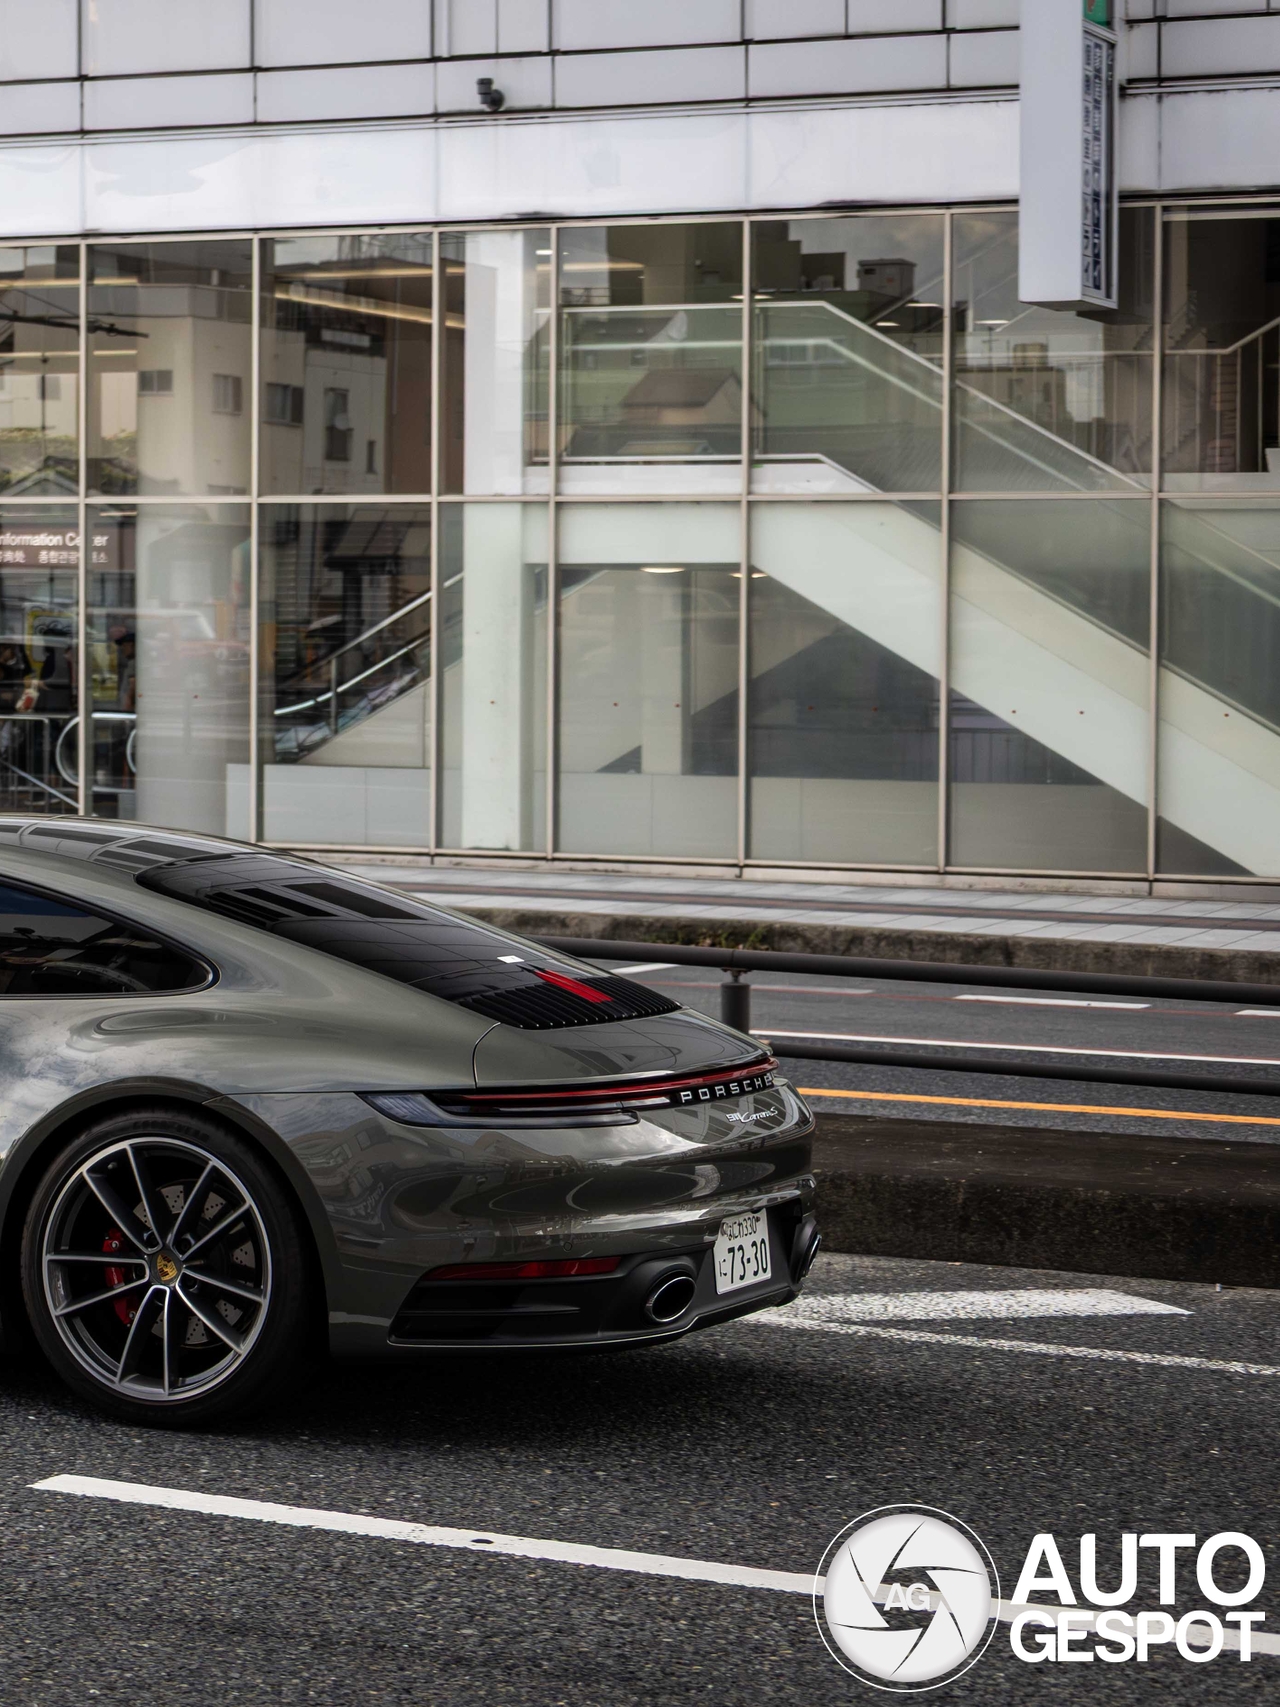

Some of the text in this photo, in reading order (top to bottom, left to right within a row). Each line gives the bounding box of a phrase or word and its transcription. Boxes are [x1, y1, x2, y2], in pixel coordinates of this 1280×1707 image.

[65, 533, 109, 547] Ceer
[680, 1072, 774, 1103] PORSCHE
[742, 1215, 757, 1237] 330
[727, 1237, 768, 1284] 73-30
